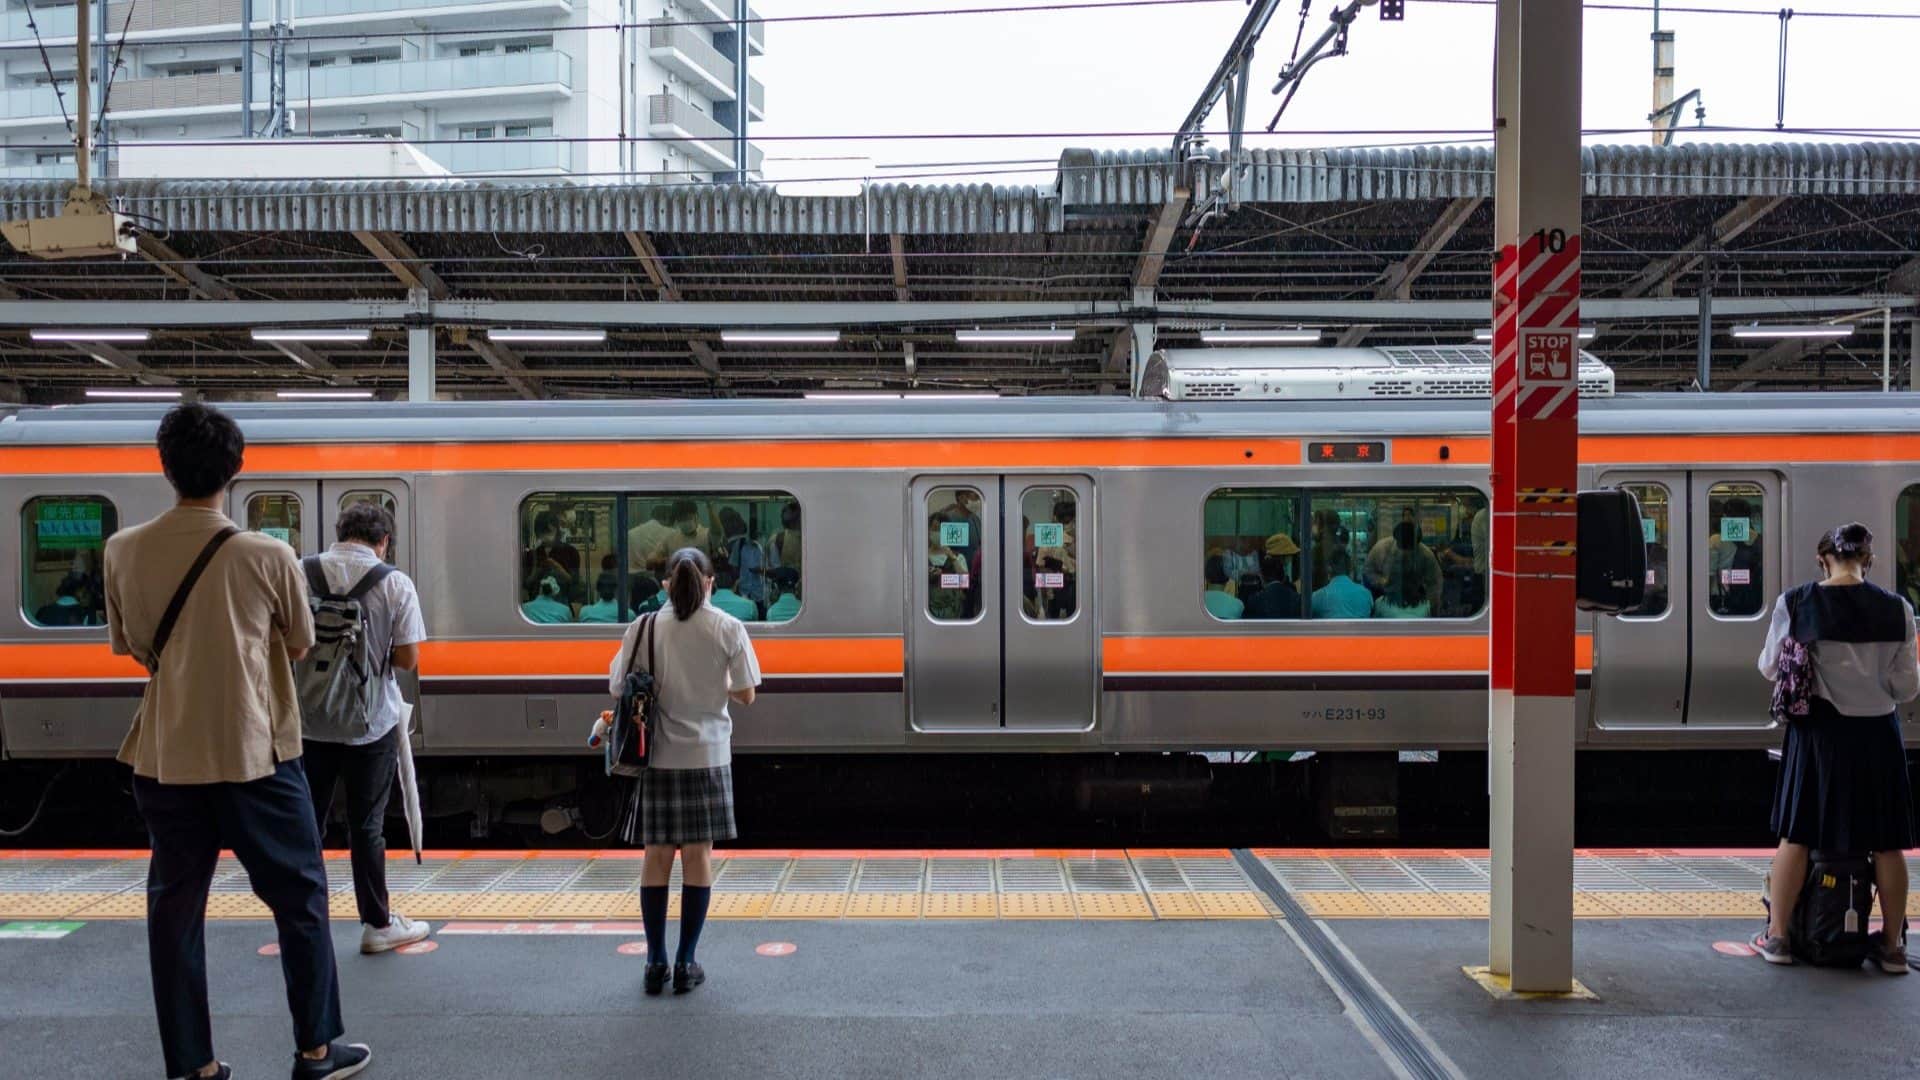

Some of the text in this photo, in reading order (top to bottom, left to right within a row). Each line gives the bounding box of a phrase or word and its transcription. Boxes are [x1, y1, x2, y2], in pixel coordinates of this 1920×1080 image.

[1534, 228, 1566, 253] 10
[1528, 336, 1568, 348] STOP
[1322, 444, 1369, 457] 東京
[1326, 708, 1385, 720] E231-93
